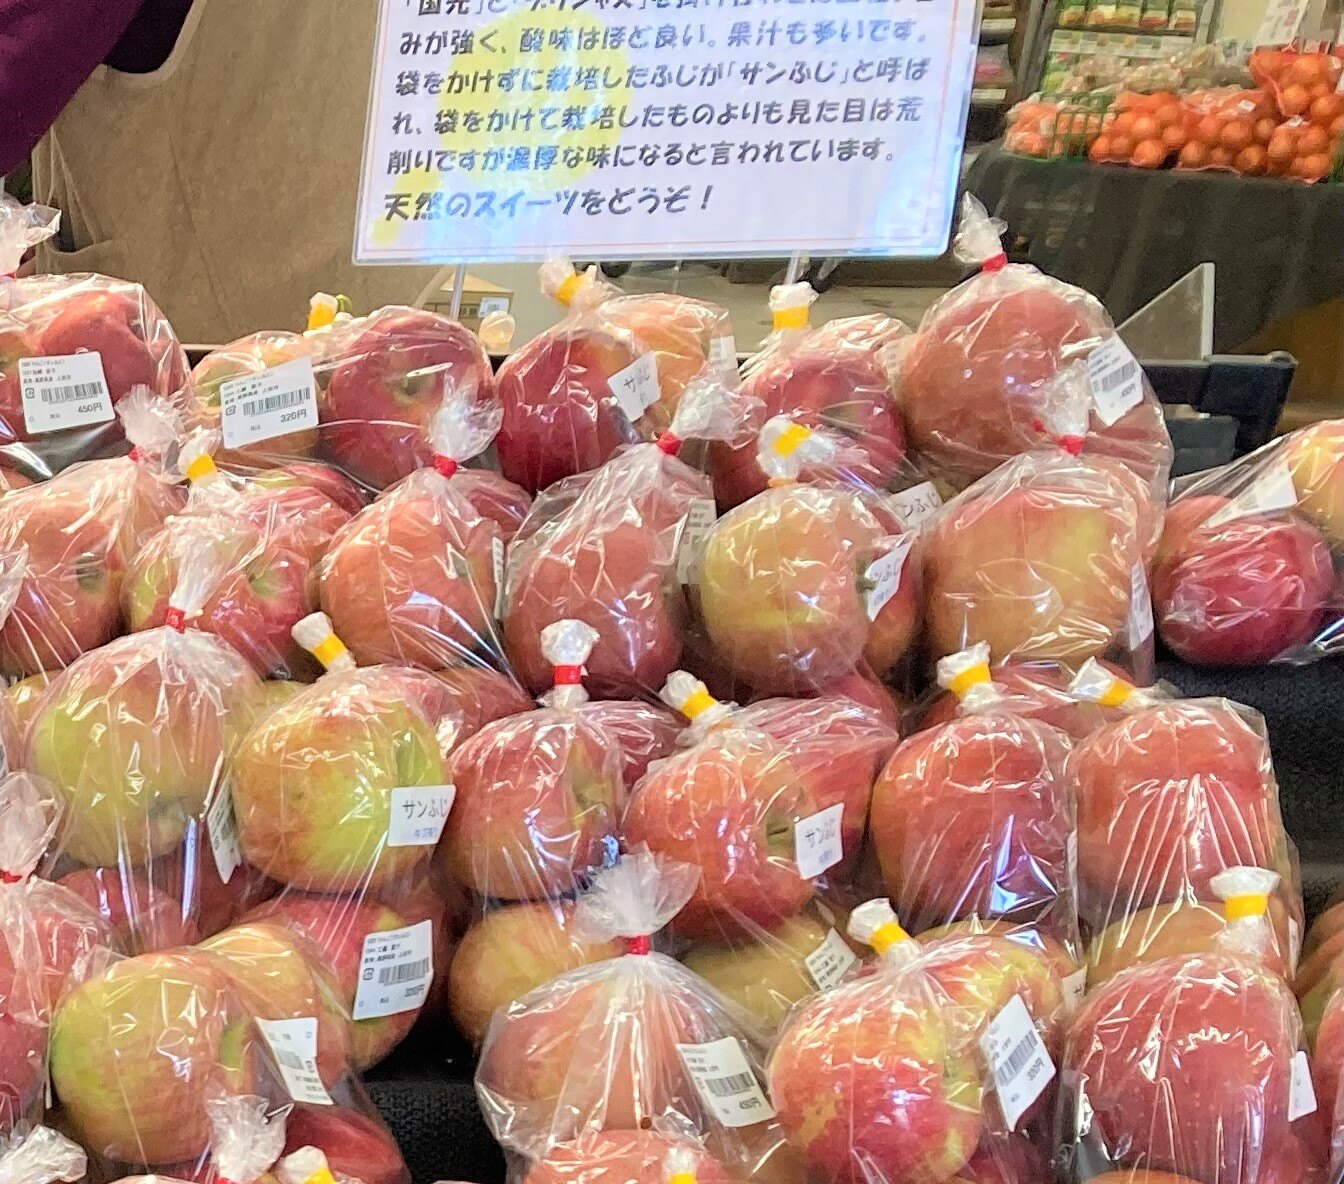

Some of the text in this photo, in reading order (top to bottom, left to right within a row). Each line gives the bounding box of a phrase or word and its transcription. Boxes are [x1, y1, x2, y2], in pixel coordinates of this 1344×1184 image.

[76, 402, 103, 414] 450円
[279, 408, 307, 424] 320円
[402, 797, 449, 820] サンふじ
